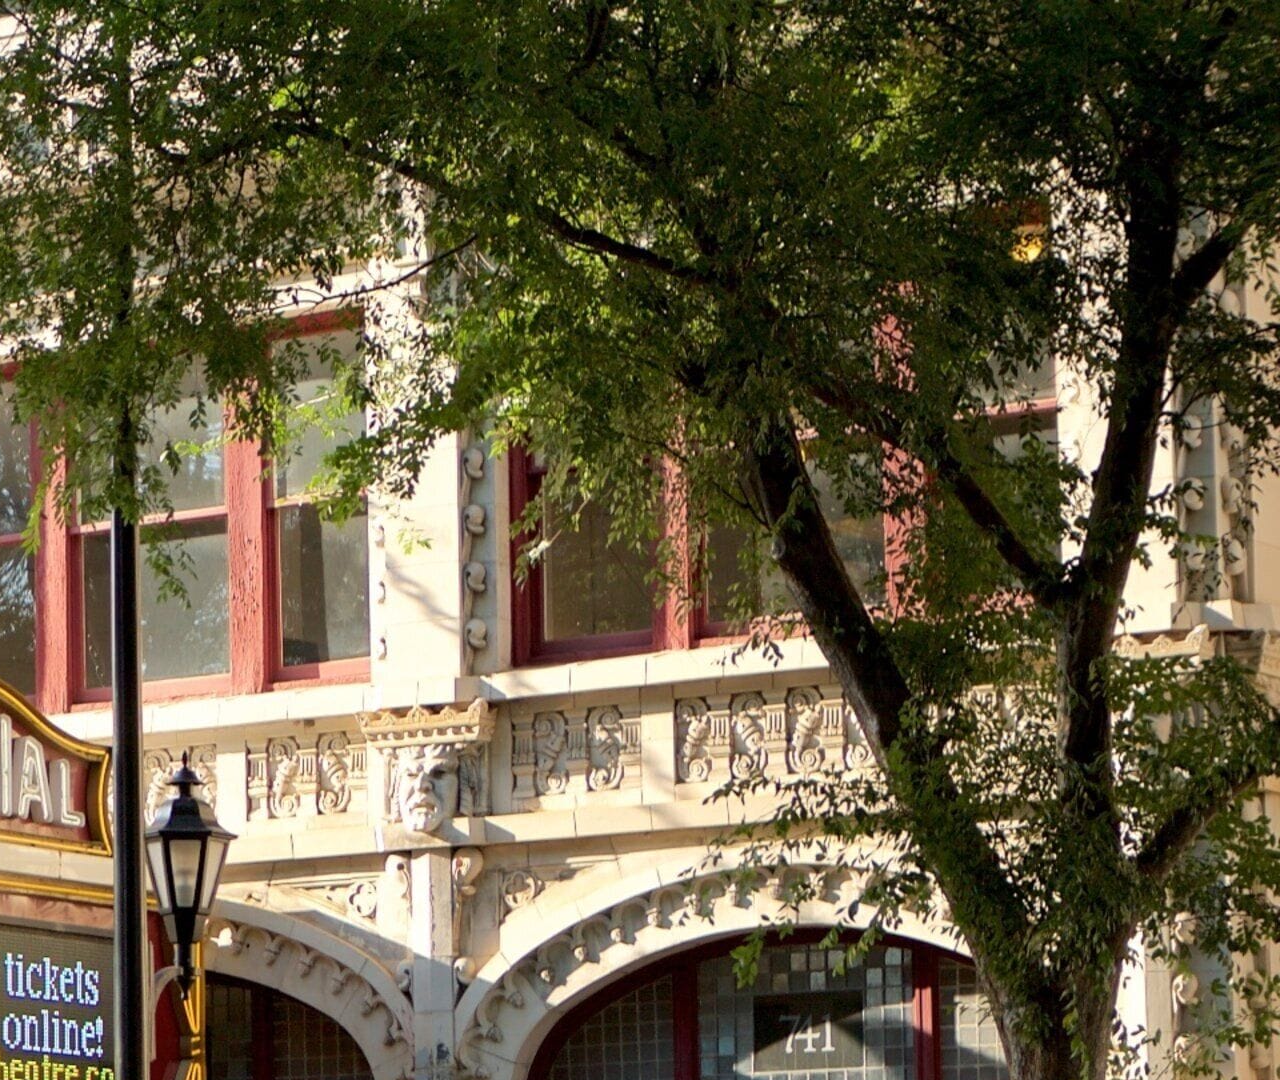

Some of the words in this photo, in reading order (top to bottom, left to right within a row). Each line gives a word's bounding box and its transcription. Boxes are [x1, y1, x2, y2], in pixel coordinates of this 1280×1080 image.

[4, 951, 100, 1006] tickets
[2, 1008, 104, 1059] online!
[779, 1012, 836, 1054] 741
